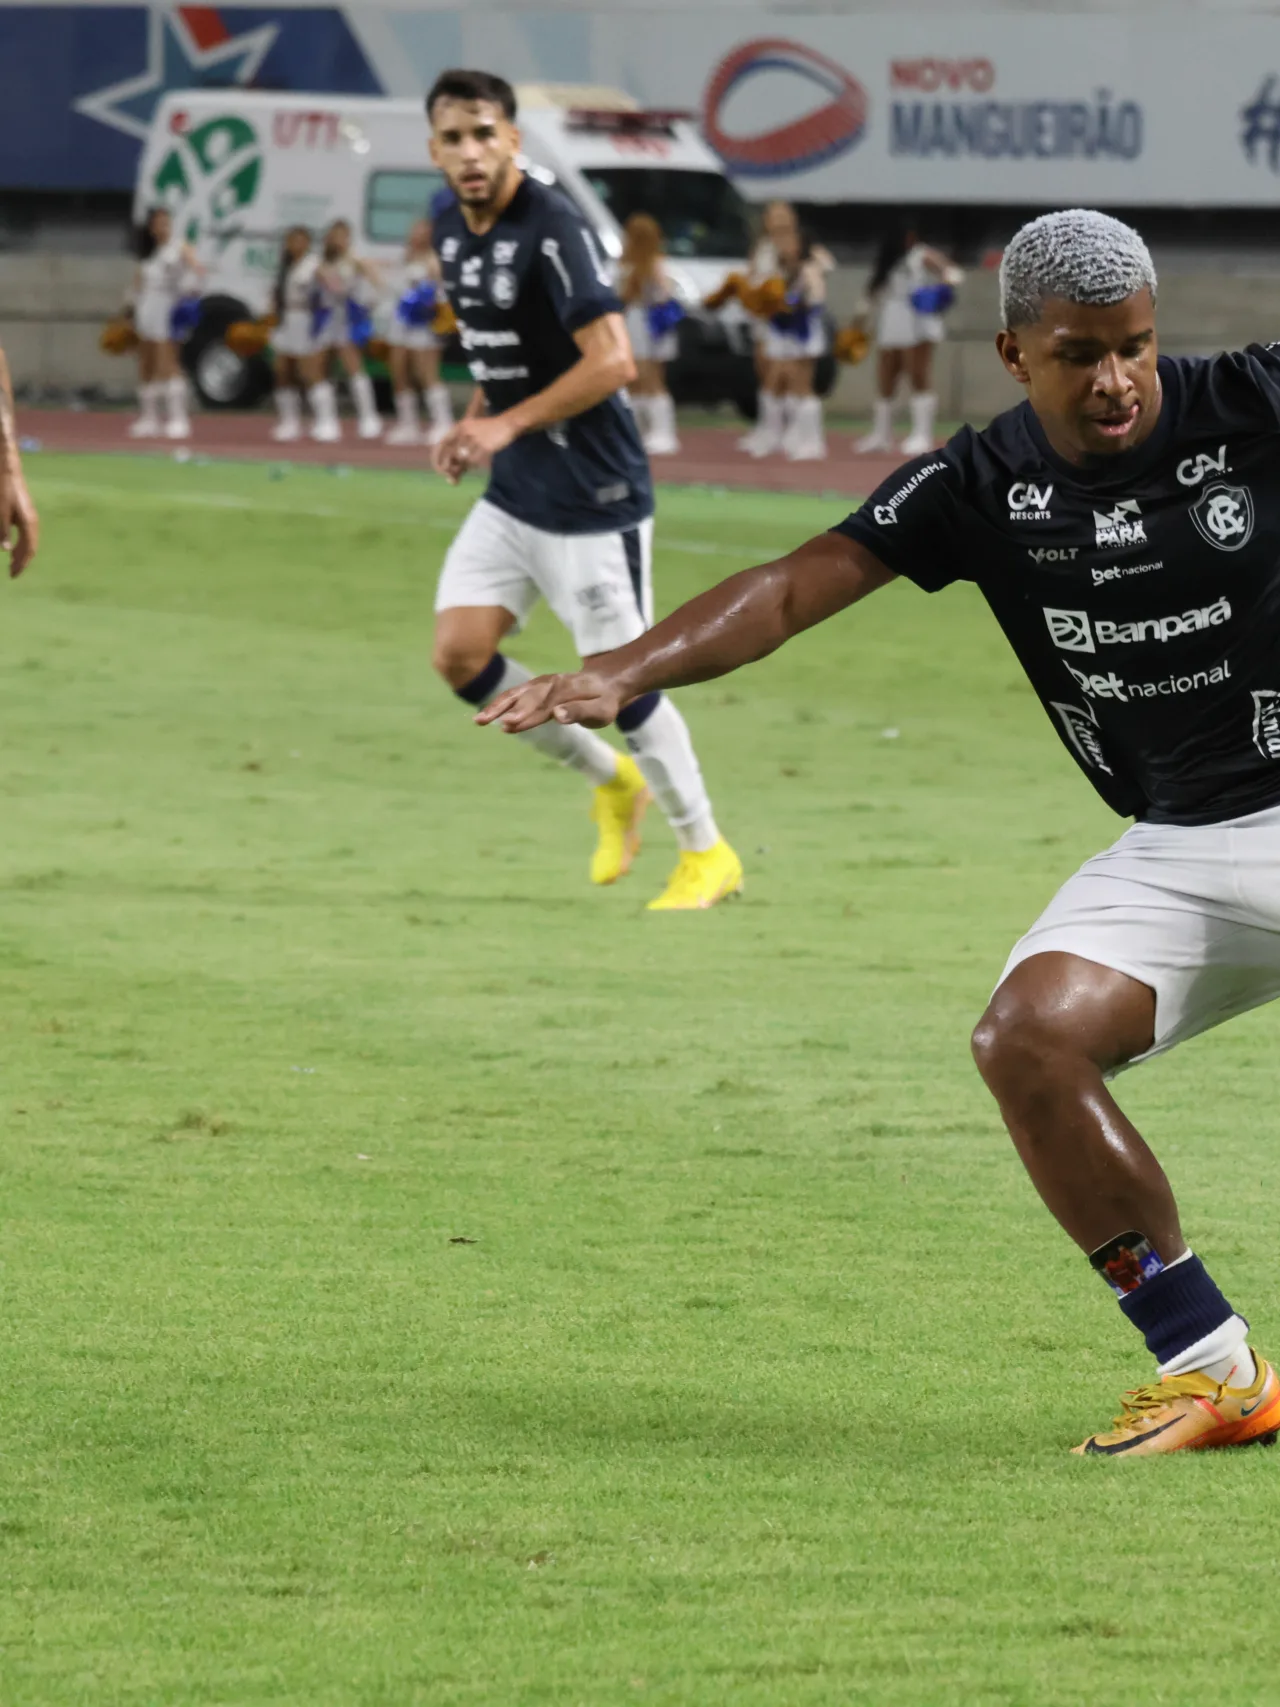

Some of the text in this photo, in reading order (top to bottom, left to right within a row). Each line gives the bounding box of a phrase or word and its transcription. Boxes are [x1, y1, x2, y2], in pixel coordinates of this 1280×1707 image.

[889, 59, 995, 92] NOVO
[272, 111, 340, 149] UTI
[890, 87, 1144, 159] MANGUEIRÃO
[888, 462, 948, 509] REINAFARMA
[1007, 482, 1054, 511] GAV
[1009, 511, 1051, 521] RESORTS
[1028, 548, 1079, 564] VOLT
[1094, 596, 1232, 642] Banpará
